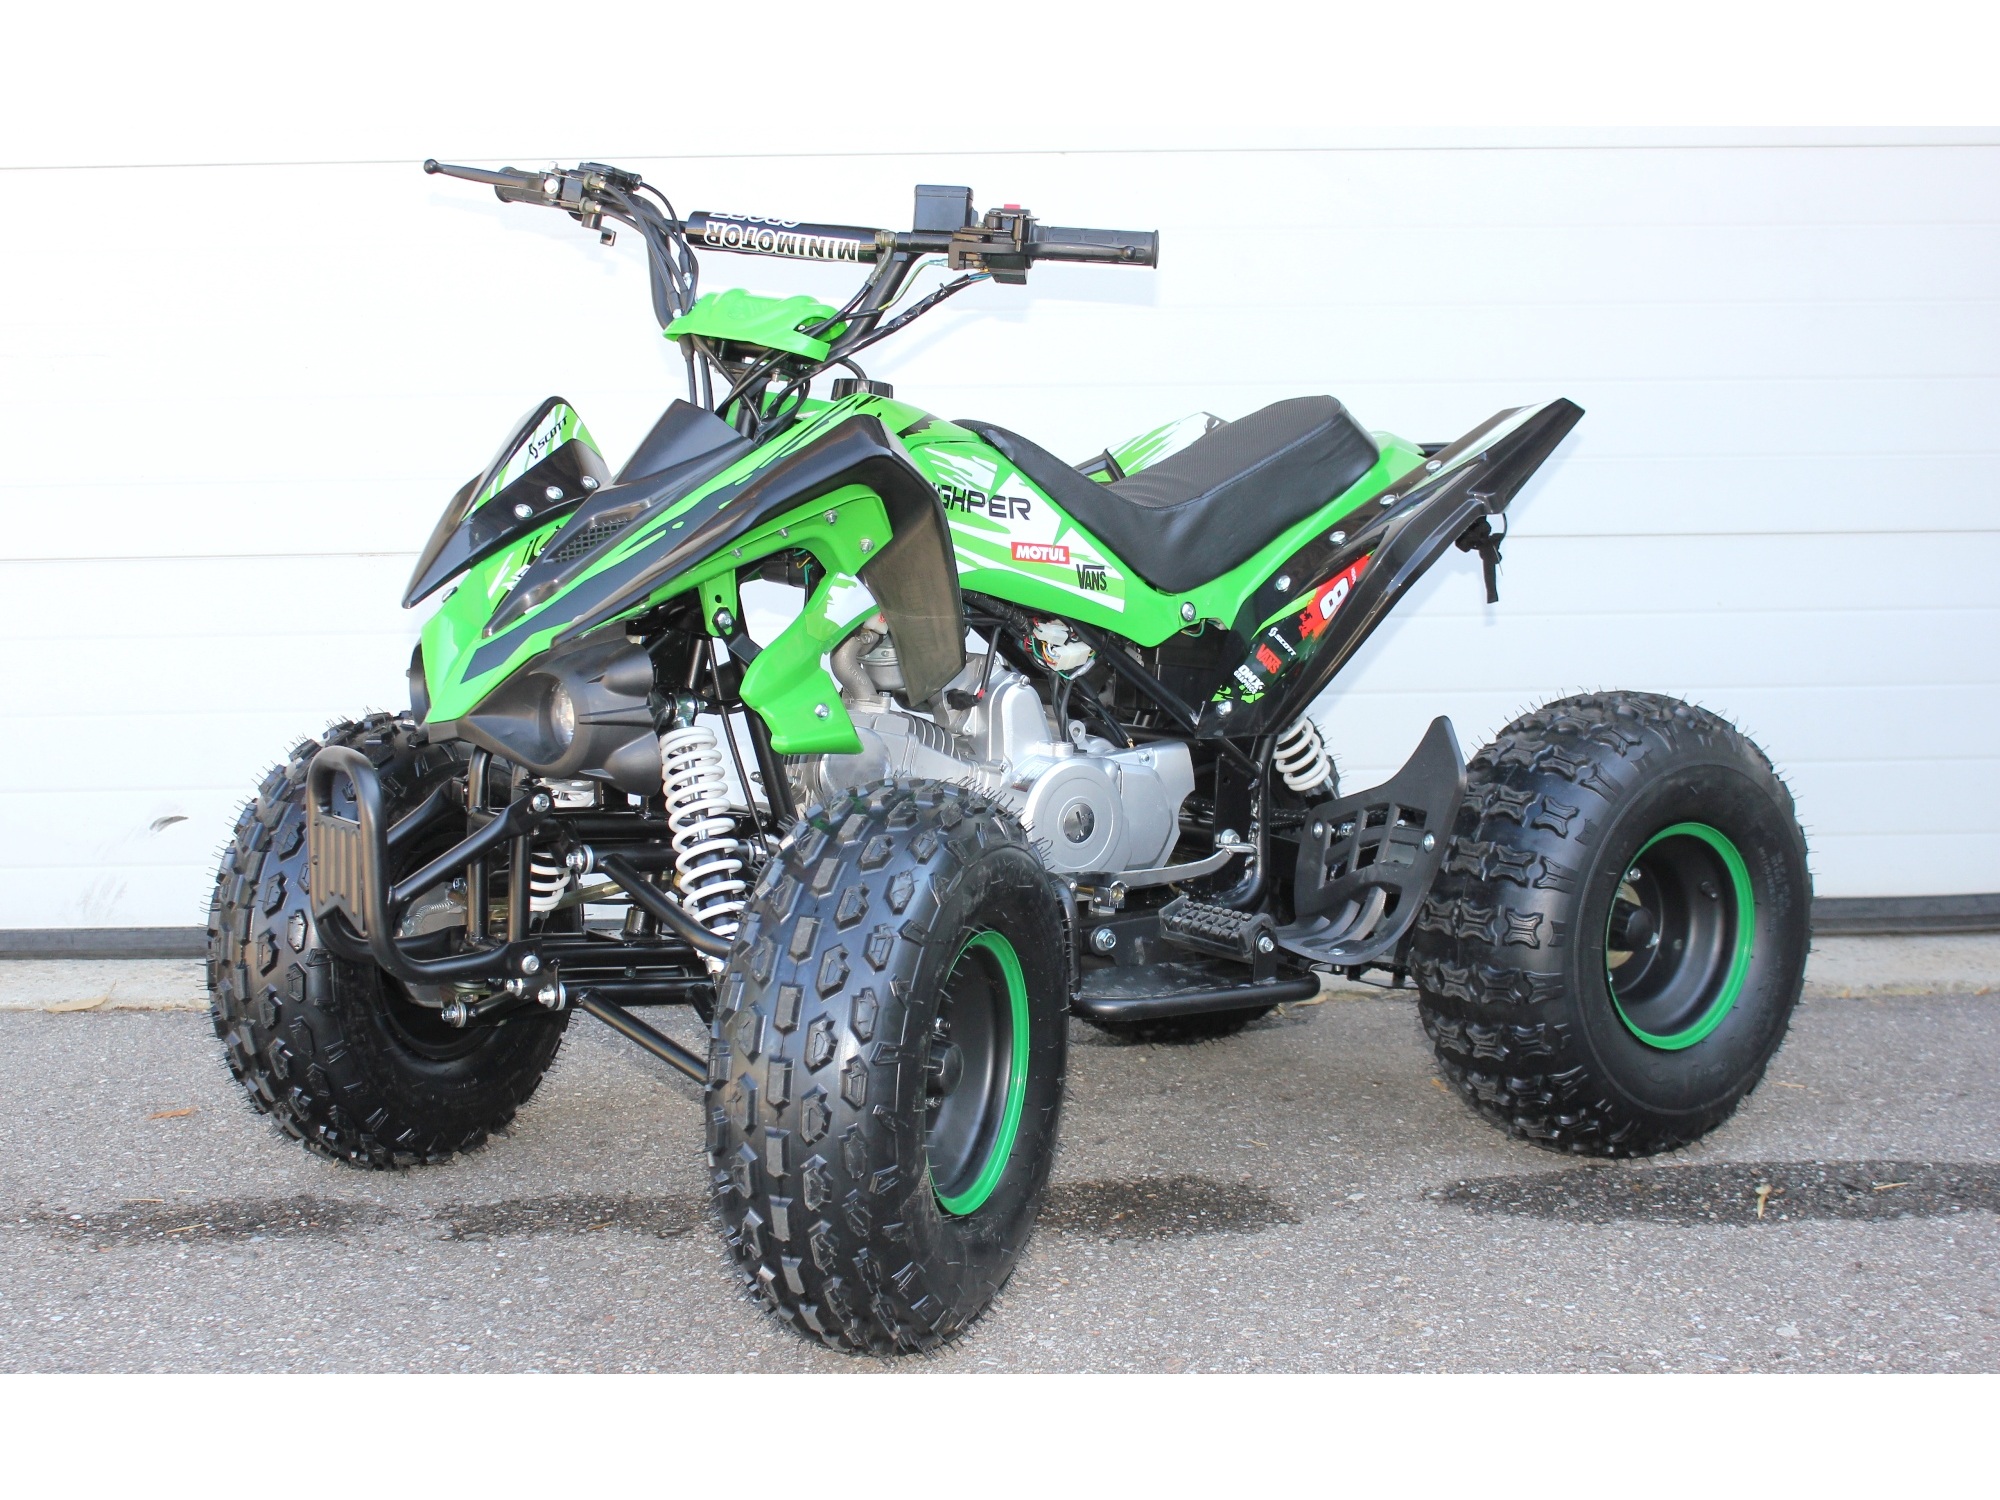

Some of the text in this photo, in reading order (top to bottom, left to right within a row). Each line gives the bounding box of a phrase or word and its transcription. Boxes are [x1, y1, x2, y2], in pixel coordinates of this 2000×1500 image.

[704, 220, 861, 263] MINIMOTOR
[537, 415, 568, 450] SCOTT
[932, 482, 1032, 521] GHPER
[1015, 544, 1067, 562] MOTUL
[1076, 563, 1106, 591] VANS
[1318, 576, 1350, 621] 8
[1255, 642, 1283, 675] VANS
[1274, 633, 1297, 656] SCOTT
[1233, 670, 1258, 695] GRAPHICS
